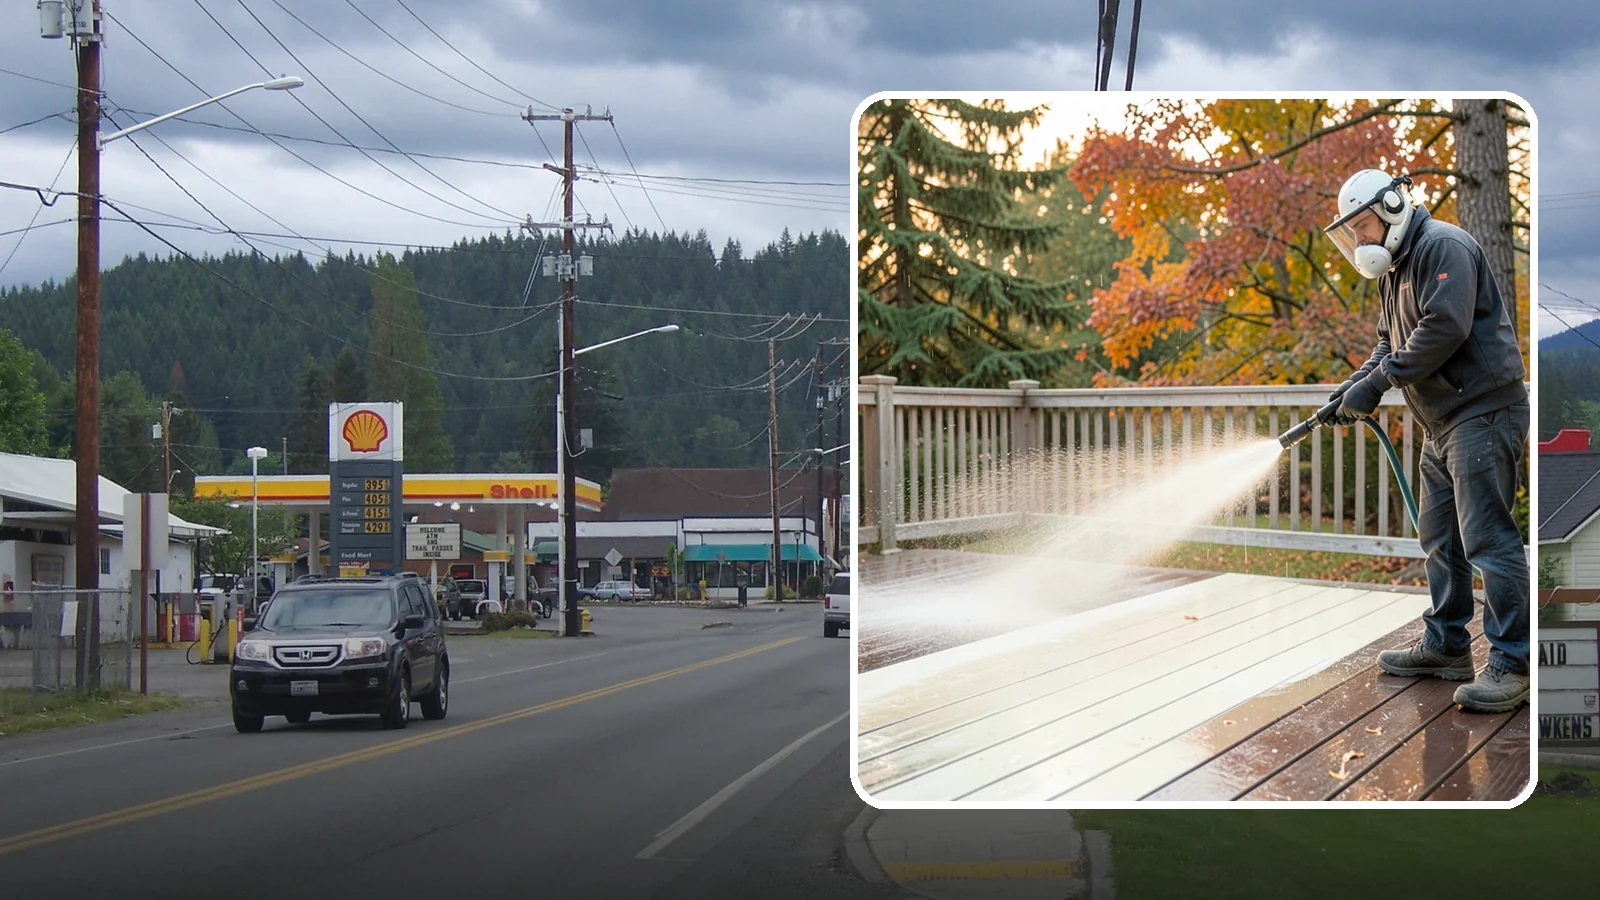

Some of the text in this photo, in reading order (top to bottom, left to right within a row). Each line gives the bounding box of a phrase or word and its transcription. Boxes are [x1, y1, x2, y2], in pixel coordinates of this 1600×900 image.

[366, 480, 383, 490] 395
[490, 484, 547, 499] Shell
[366, 494, 384, 504] 405
[366, 508, 383, 518] 415
[366, 522, 383, 532] 429
